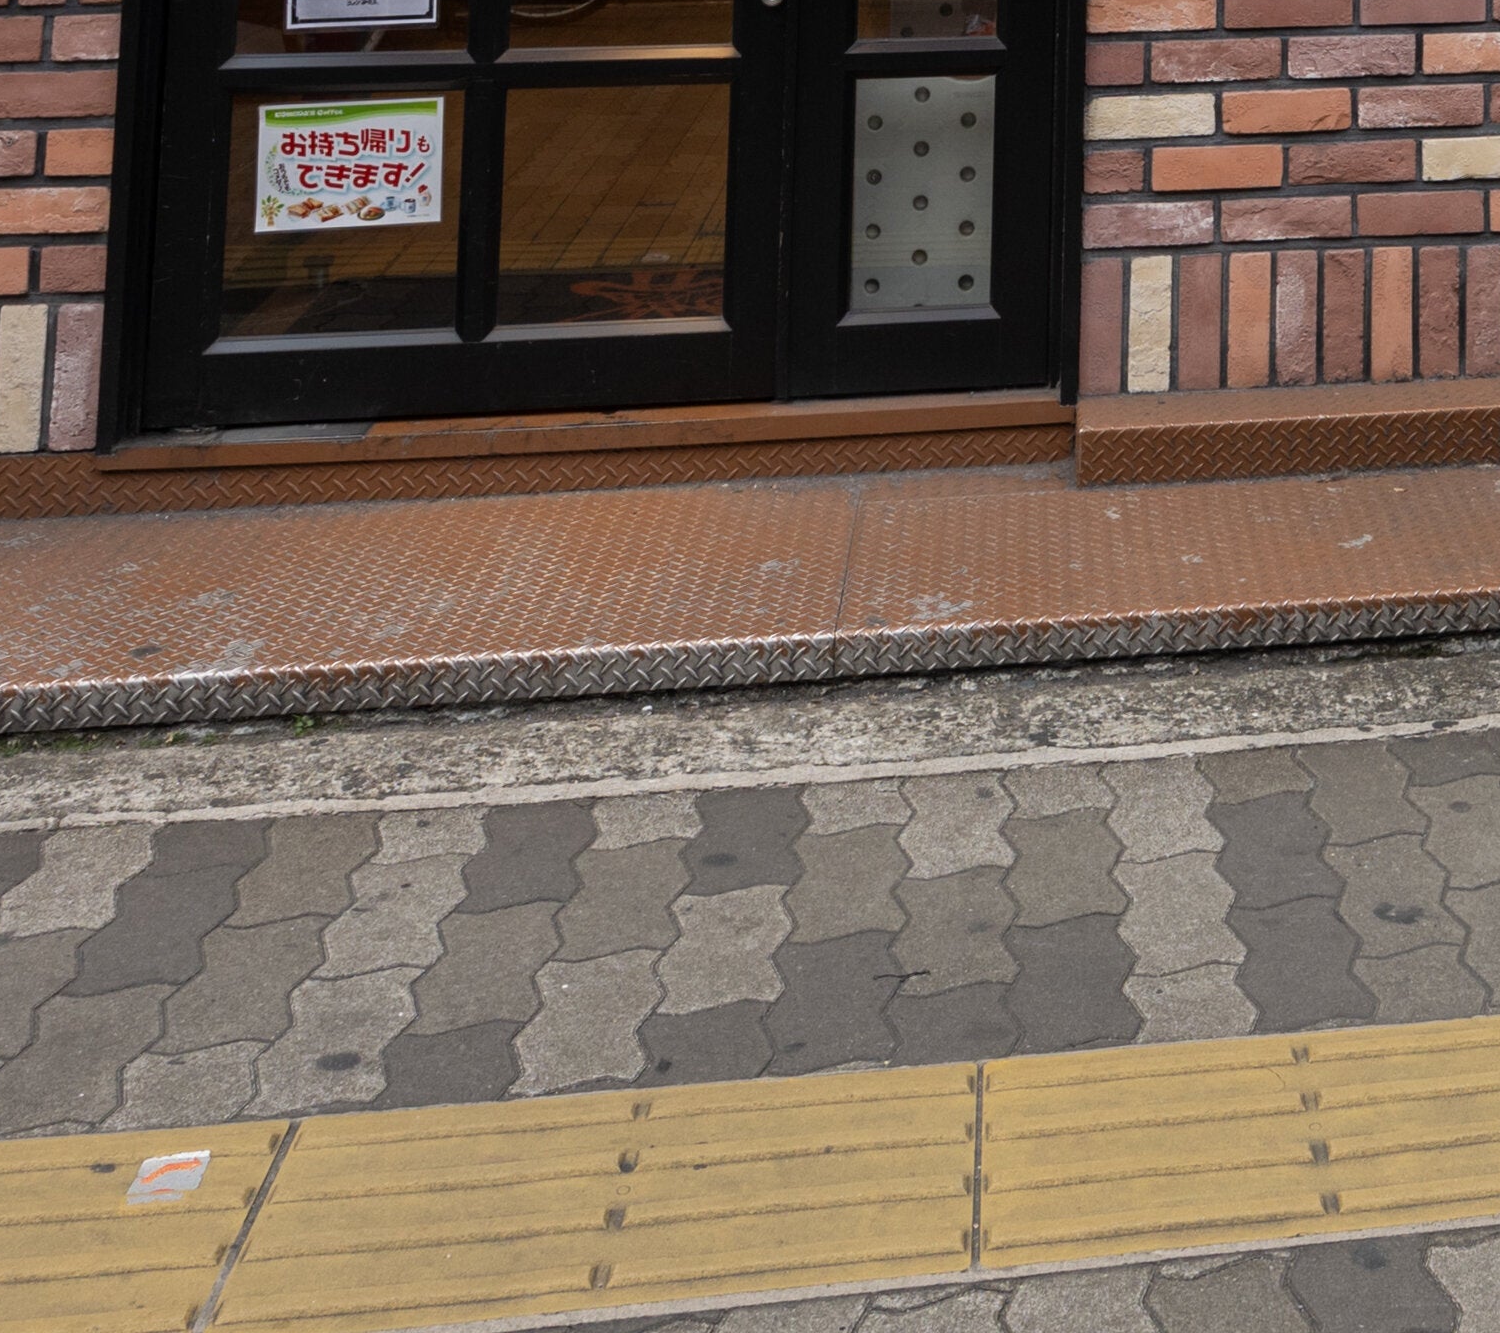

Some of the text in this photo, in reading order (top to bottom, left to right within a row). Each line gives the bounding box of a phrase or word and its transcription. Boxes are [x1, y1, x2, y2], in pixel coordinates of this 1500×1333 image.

[280, 128, 431, 157] お持ち帰りも
[297, 162, 426, 190] できます!
